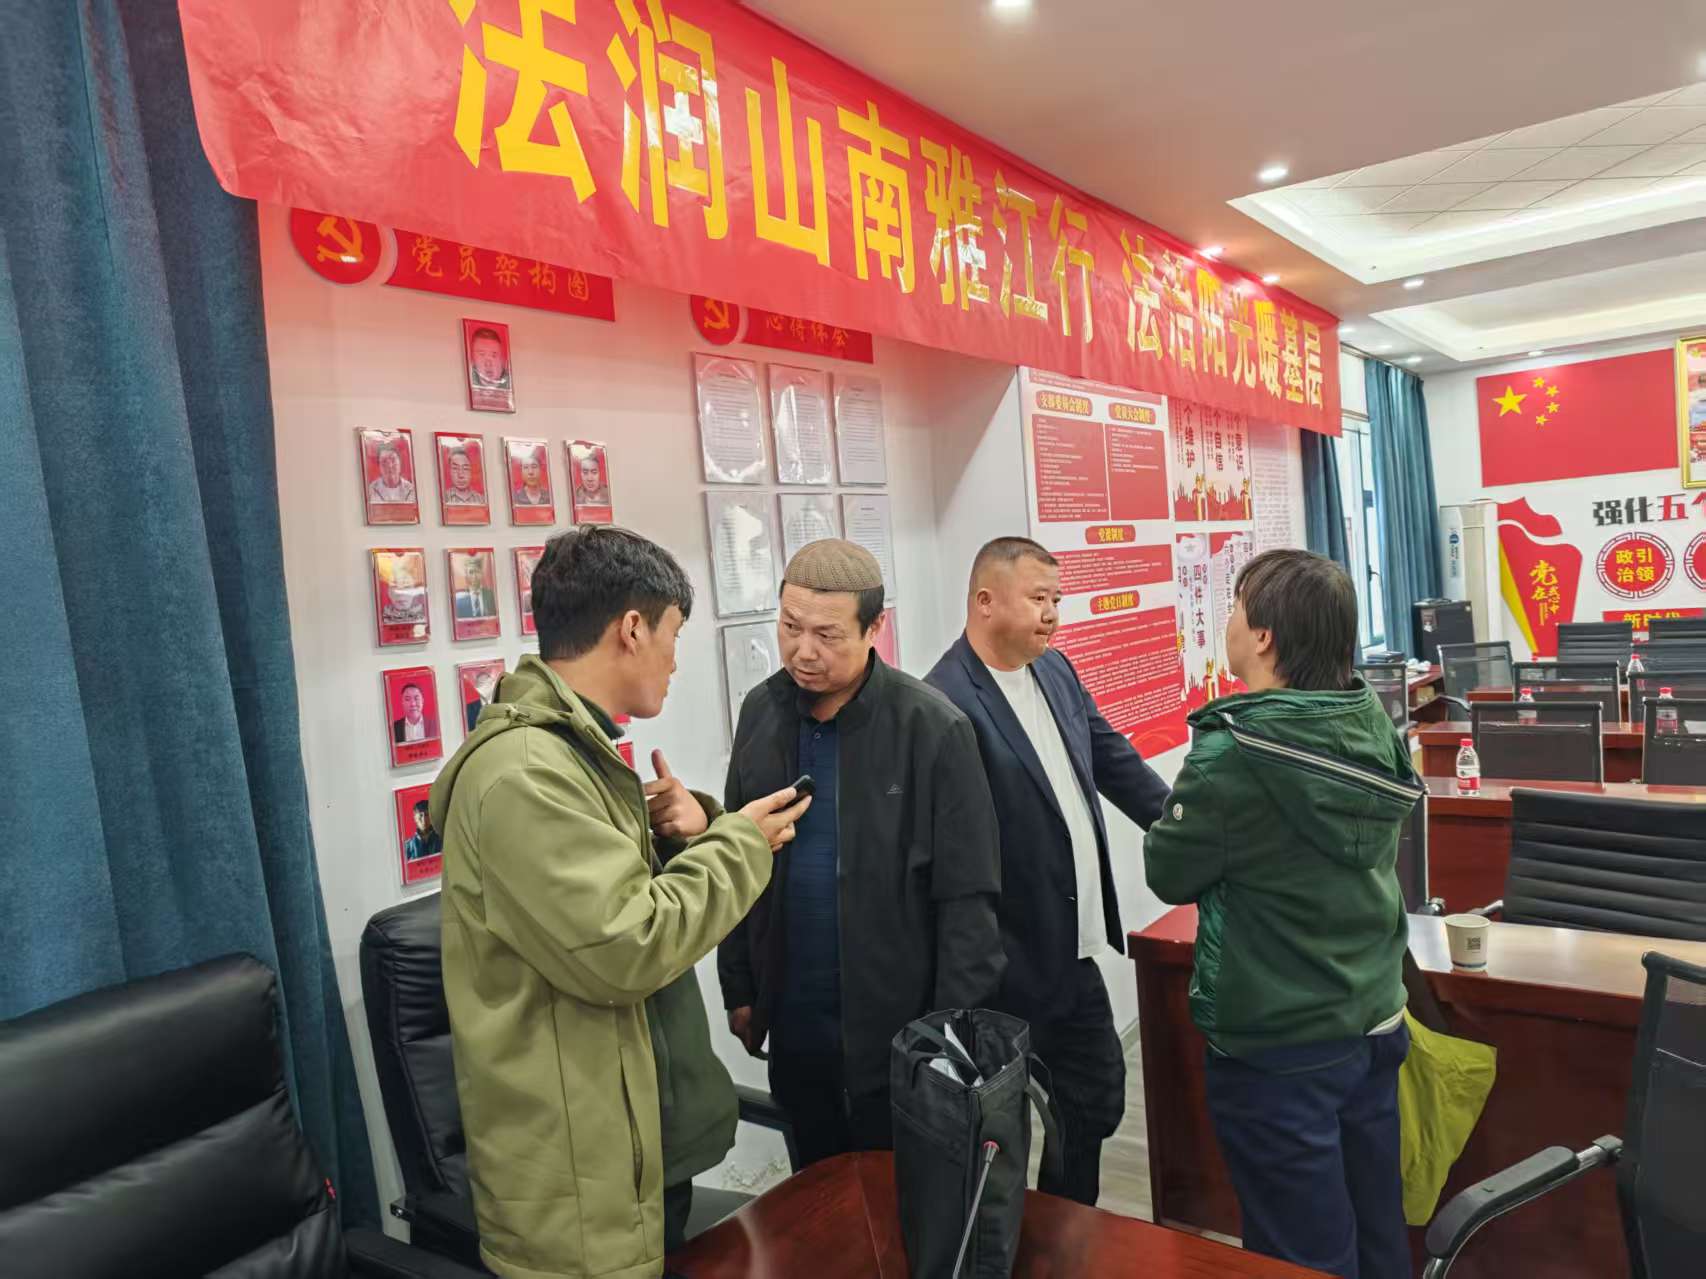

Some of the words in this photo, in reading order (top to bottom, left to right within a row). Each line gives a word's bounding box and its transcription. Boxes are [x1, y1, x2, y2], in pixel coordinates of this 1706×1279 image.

[411, 237, 590, 301] 党员架构图
[449, 0, 1095, 343] 法润山南雅江行
[1120, 228, 1323, 410] 法治阳光暖基层
